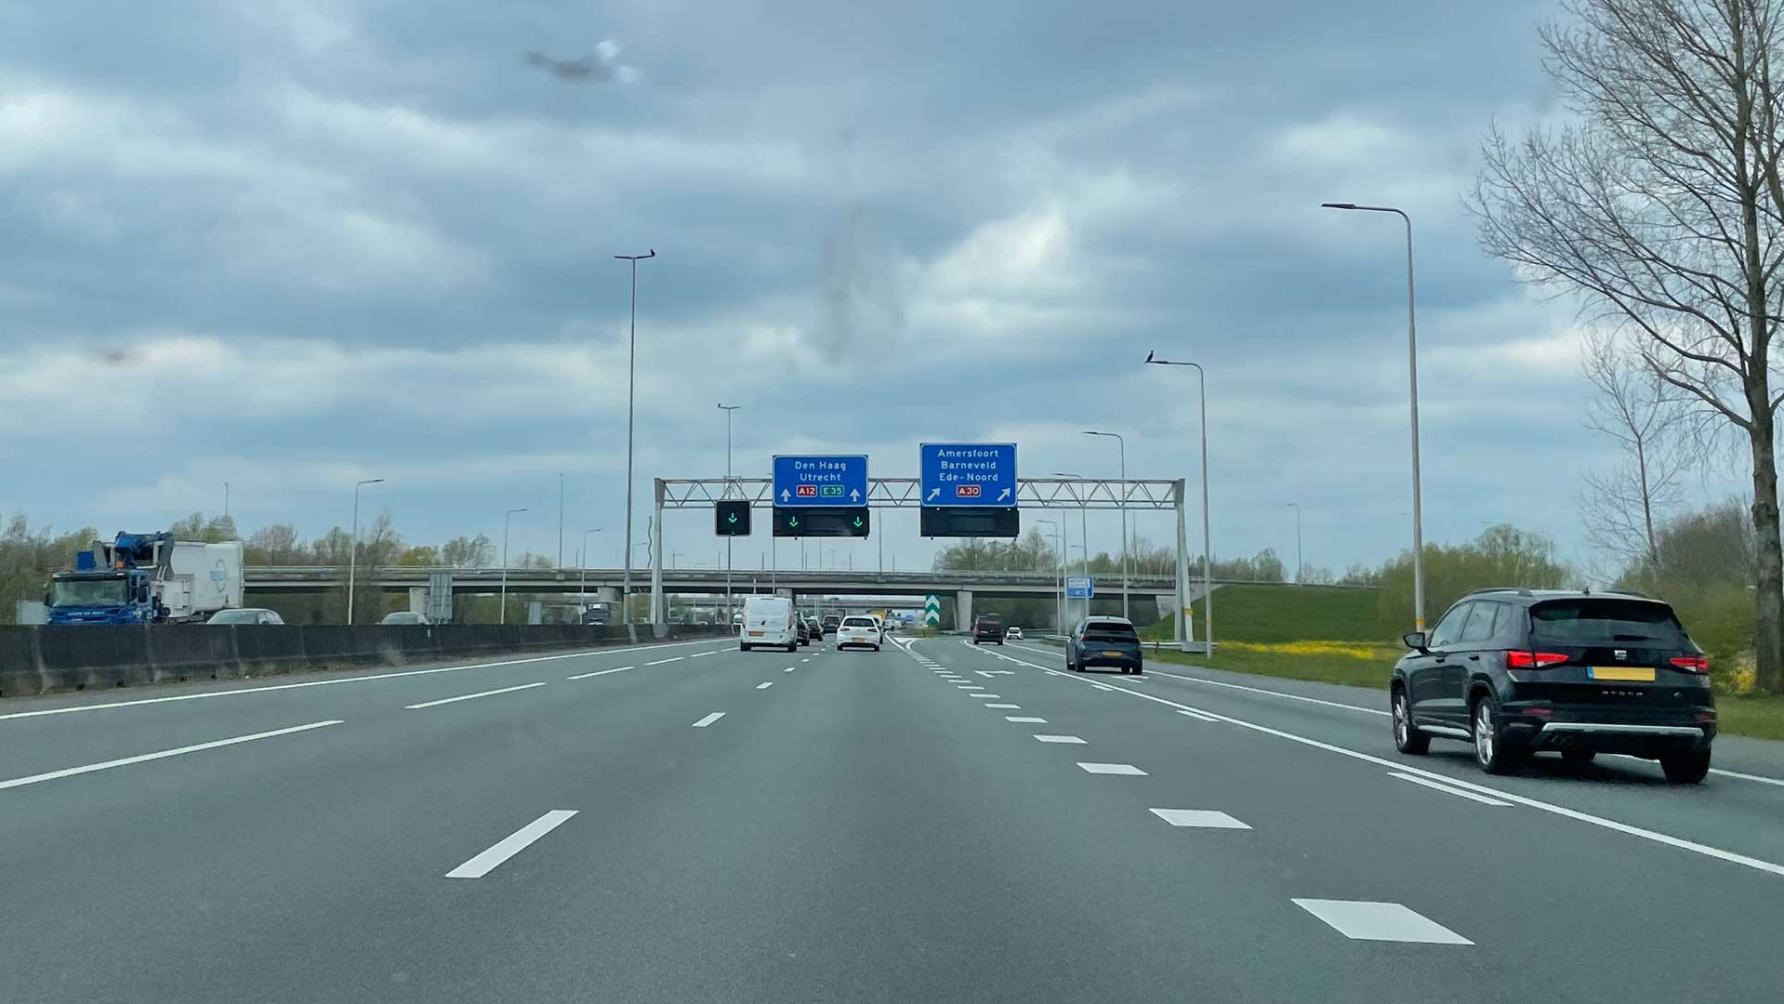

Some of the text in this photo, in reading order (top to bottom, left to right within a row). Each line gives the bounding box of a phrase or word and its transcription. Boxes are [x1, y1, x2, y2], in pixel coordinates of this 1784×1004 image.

[937, 449, 999, 457] Amersfoort
[794, 461, 847, 472] Den Haag
[940, 460, 997, 469] Barneveld
[799, 472, 842, 481] Utrecht
[798, 487, 816, 495] A12
[958, 487, 979, 495] A30
